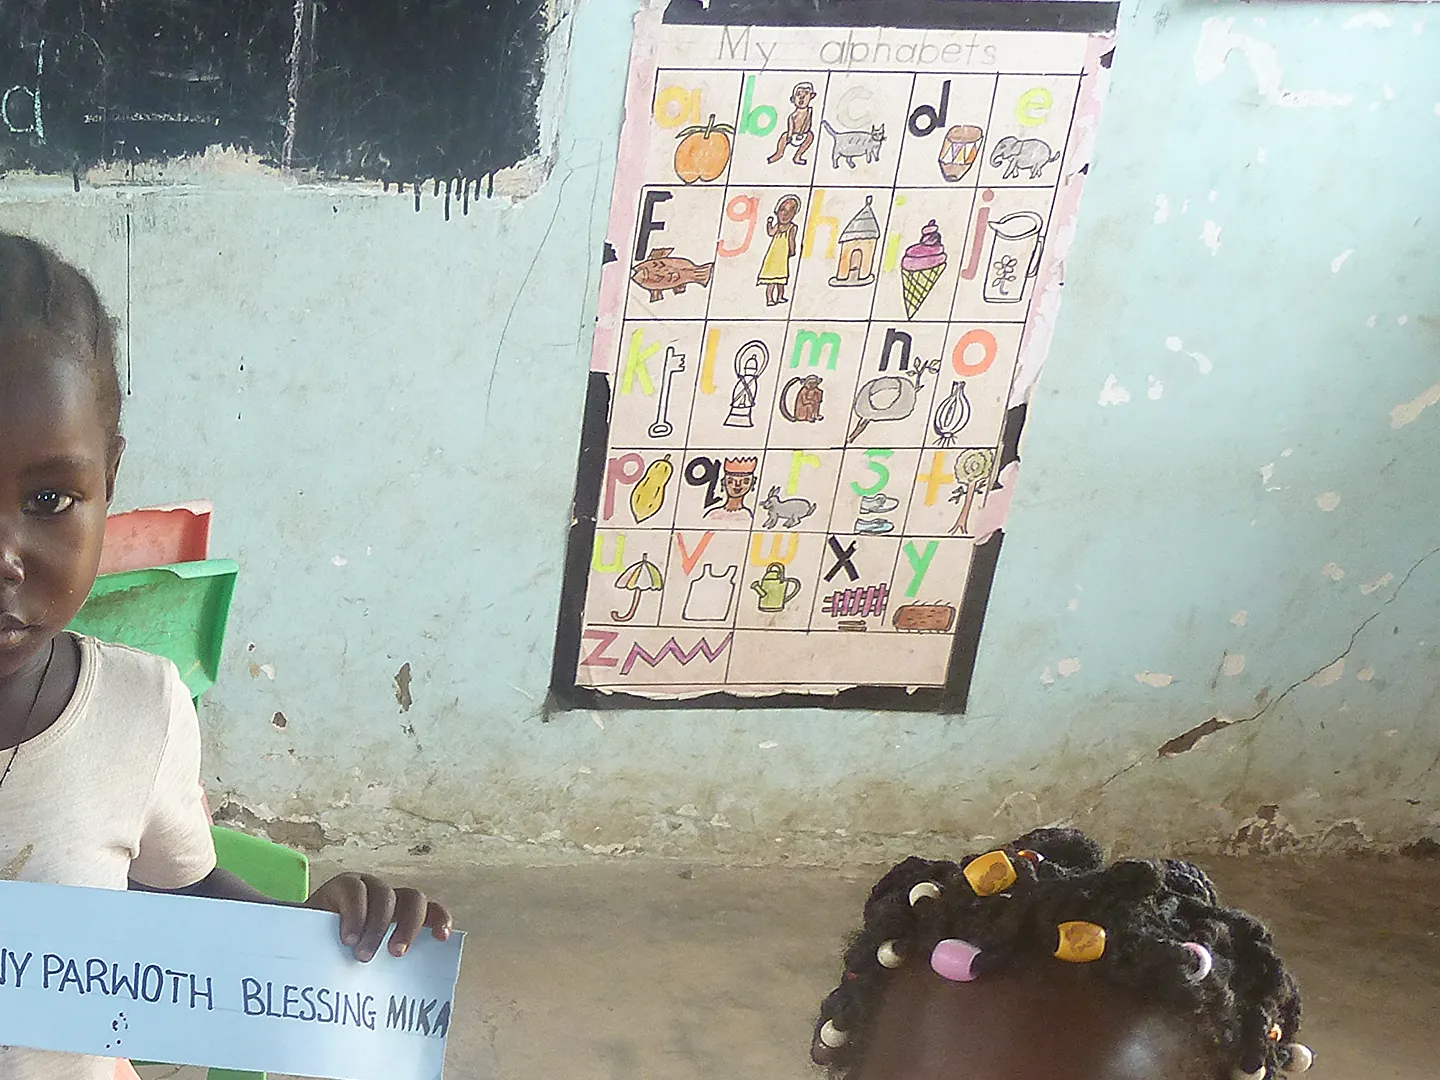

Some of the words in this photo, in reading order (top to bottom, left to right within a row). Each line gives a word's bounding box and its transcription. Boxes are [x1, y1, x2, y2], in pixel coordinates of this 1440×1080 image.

[718, 27, 777, 65] My
[819, 30, 998, 66] alphabets
[653, 83, 700, 129] a
[739, 76, 777, 137] b
[837, 84, 873, 128] c
[908, 80, 950, 137] d
[1017, 86, 1054, 125] e
[635, 190, 674, 260] F
[717, 194, 758, 258] g
[801, 190, 840, 259] h
[883, 196, 907, 274] i
[959, 189, 995, 280] j
[621, 328, 663, 397] k
[792, 328, 842, 370] m
[879, 327, 915, 372] n
[952, 328, 998, 376] o
[603, 451, 645, 521] p
[684, 456, 723, 510] q
[786, 450, 821, 496] r
[916, 457, 954, 507] t
[593, 532, 626, 574] u
[750, 532, 798, 567] w
[901, 539, 939, 597] y
[43, 954, 213, 1010] PARWOTH
[242, 976, 376, 1030] BLESSING
[385, 995, 451, 1038] MIKA
